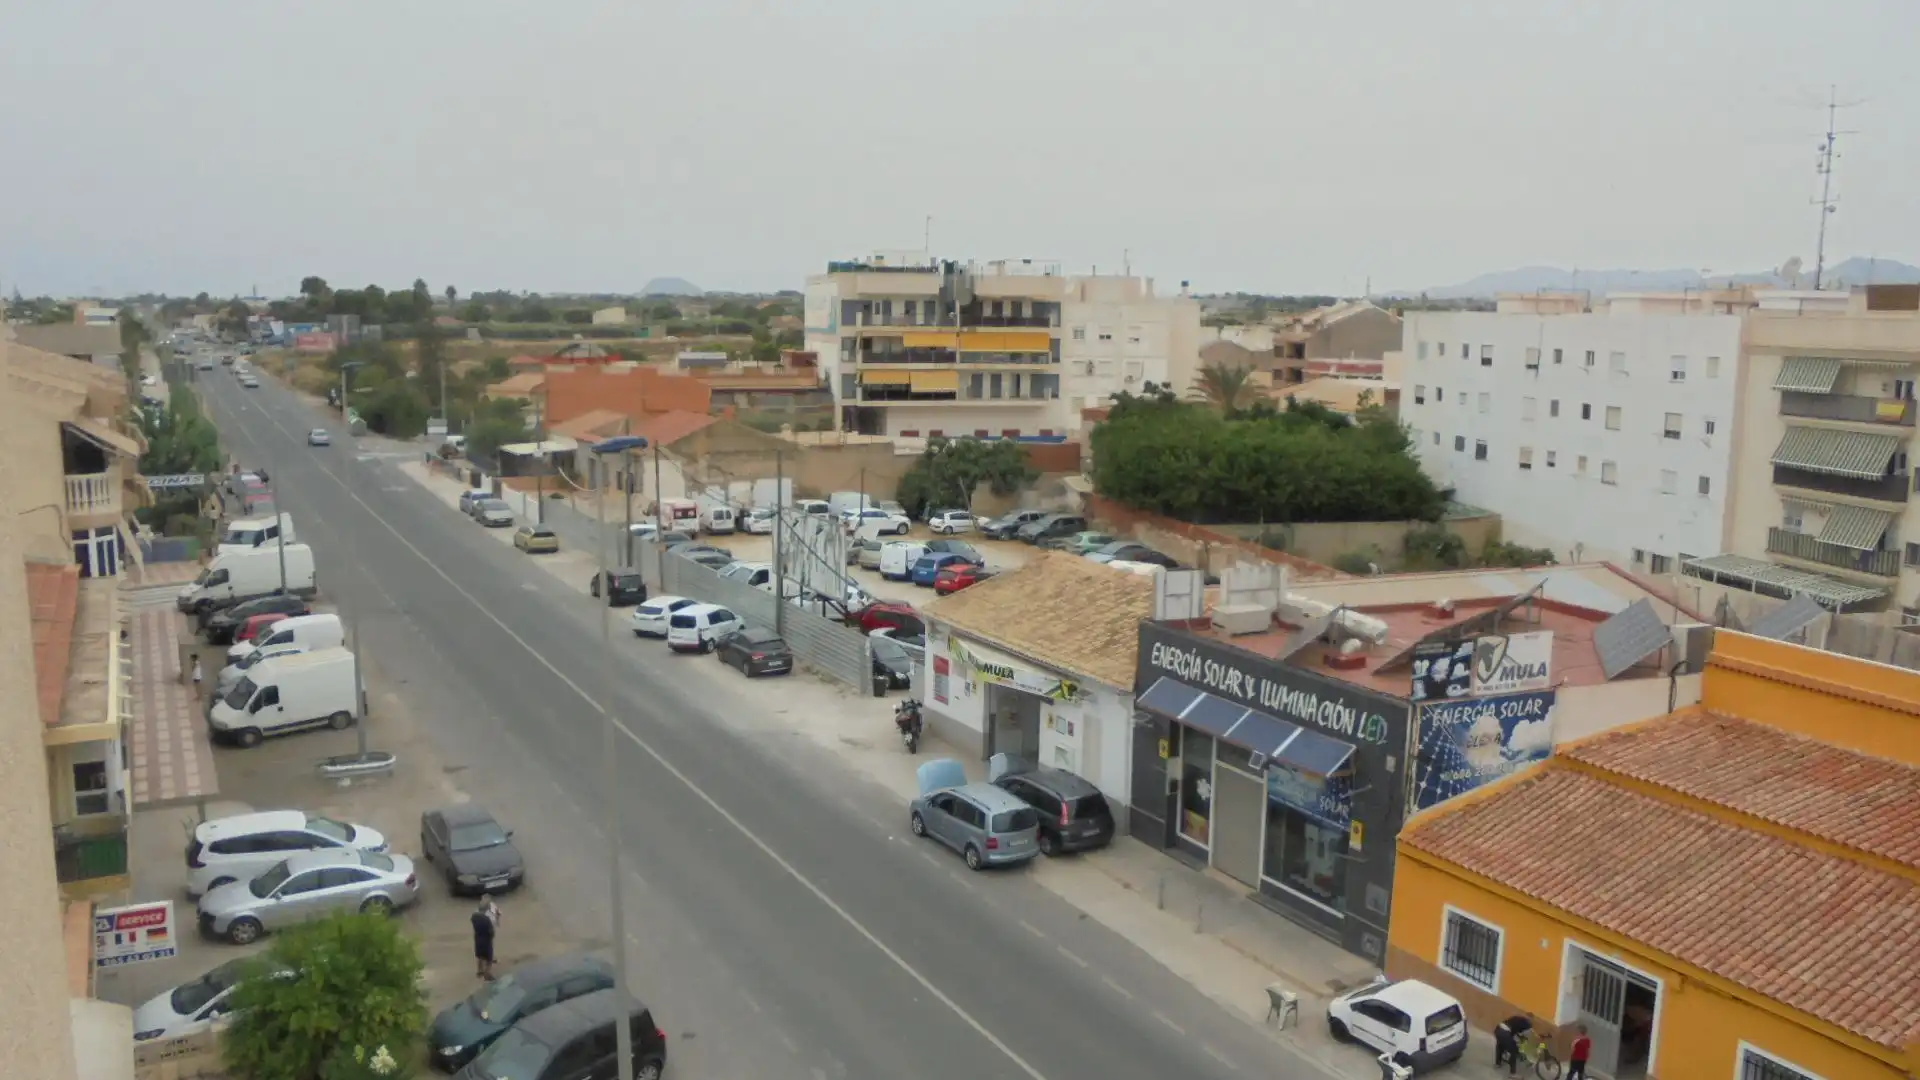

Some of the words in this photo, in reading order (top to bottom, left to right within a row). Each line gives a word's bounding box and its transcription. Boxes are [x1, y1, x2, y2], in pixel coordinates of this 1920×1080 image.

[983, 663, 1015, 680] MULA
[1499, 661, 1547, 682] MULA
[1152, 642, 1201, 681] ENERGÍA
[1203, 658, 1242, 697] SOLAR
[1260, 679, 1355, 735] ILUMINACIÓN
[1357, 711, 1388, 745] LED
[1500, 698, 1543, 720] SOLAR
[1320, 795, 1349, 819] SOLAR
[120, 913, 163, 926] SERVICE
